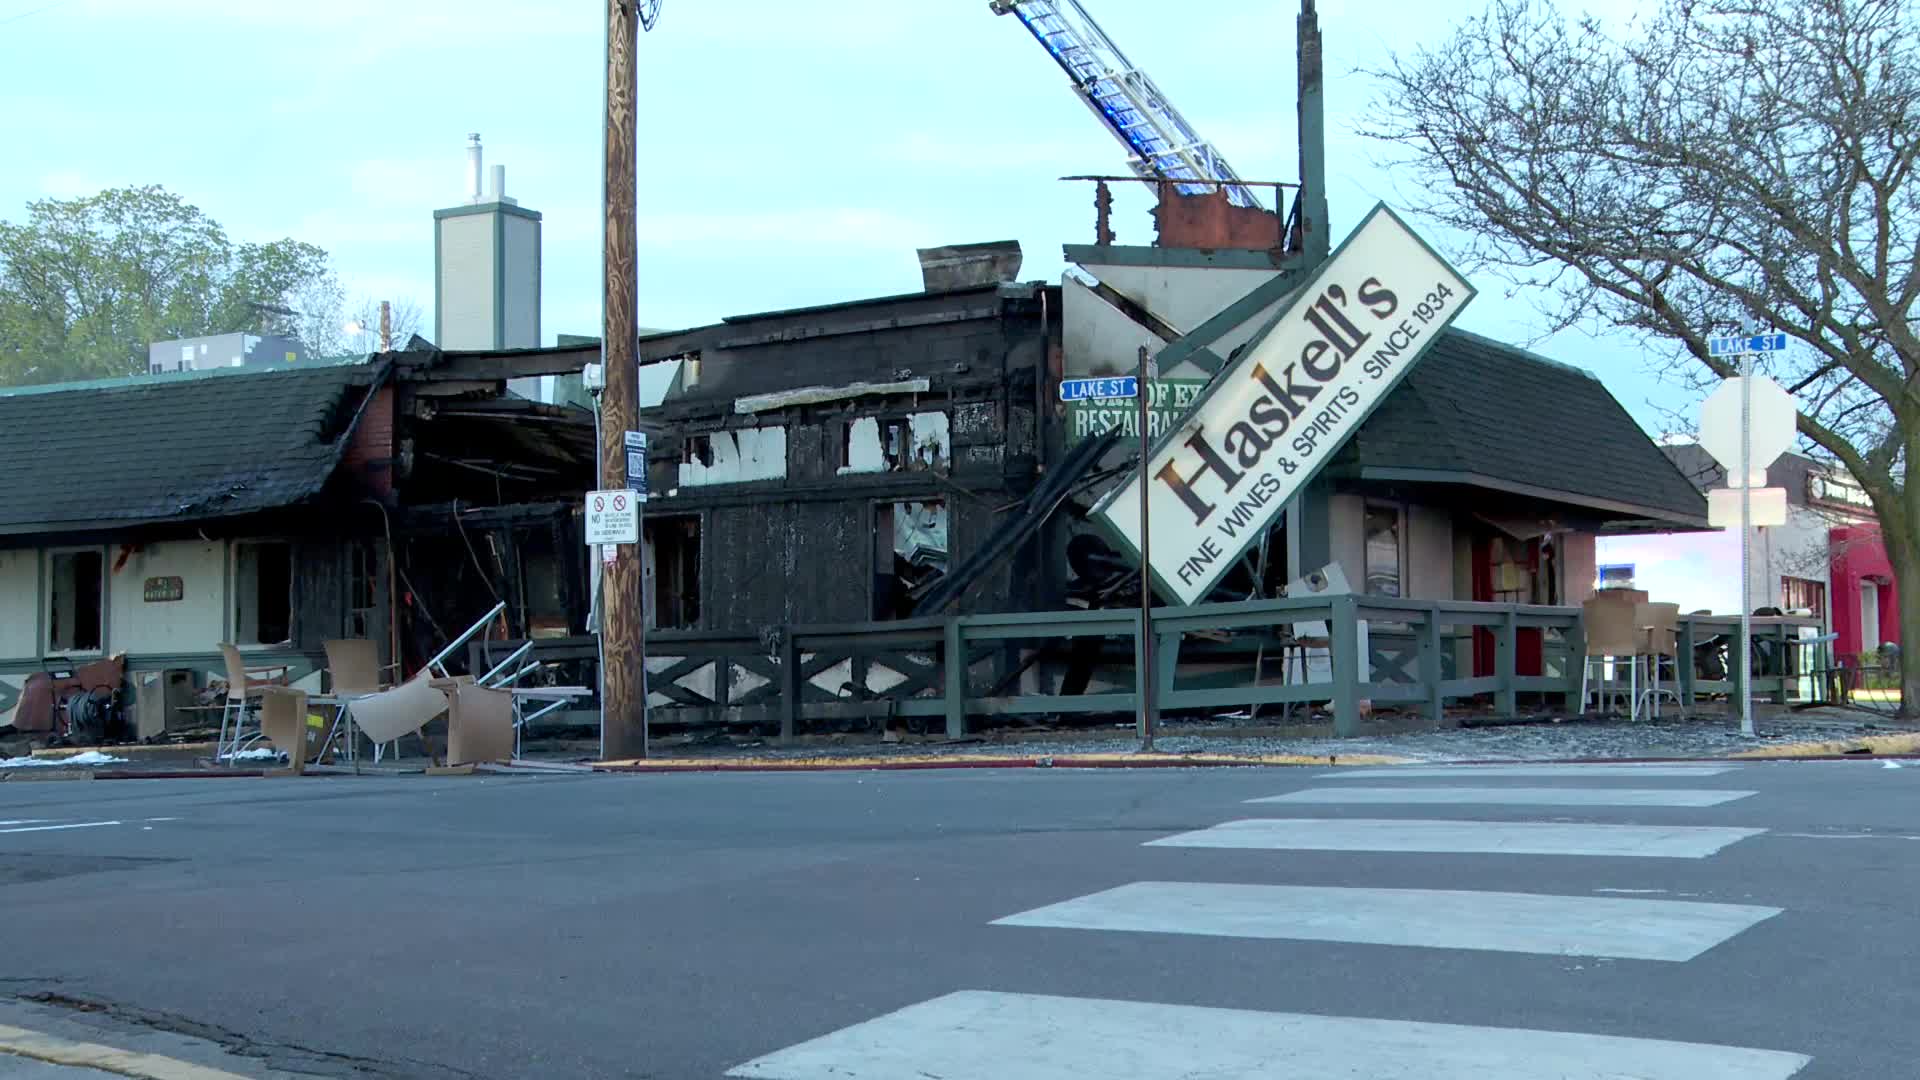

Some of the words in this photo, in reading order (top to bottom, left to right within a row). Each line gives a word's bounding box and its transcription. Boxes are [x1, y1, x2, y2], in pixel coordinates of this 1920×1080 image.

[1071, 381, 1105, 398] LAKE
[1110, 379, 1126, 396] ST
[1153, 276, 1398, 526] Haskell's
[1718, 337, 1752, 353] LAKE
[1761, 335, 1779, 351] ST
[1176, 537, 1223, 587] FINE
[1217, 472, 1282, 538] WINES
[1277, 457, 1297, 476] &
[1292, 385, 1360, 458] SPIRITS
[1363, 319, 1420, 381] SINCE
[1411, 281, 1454, 326] 1934
